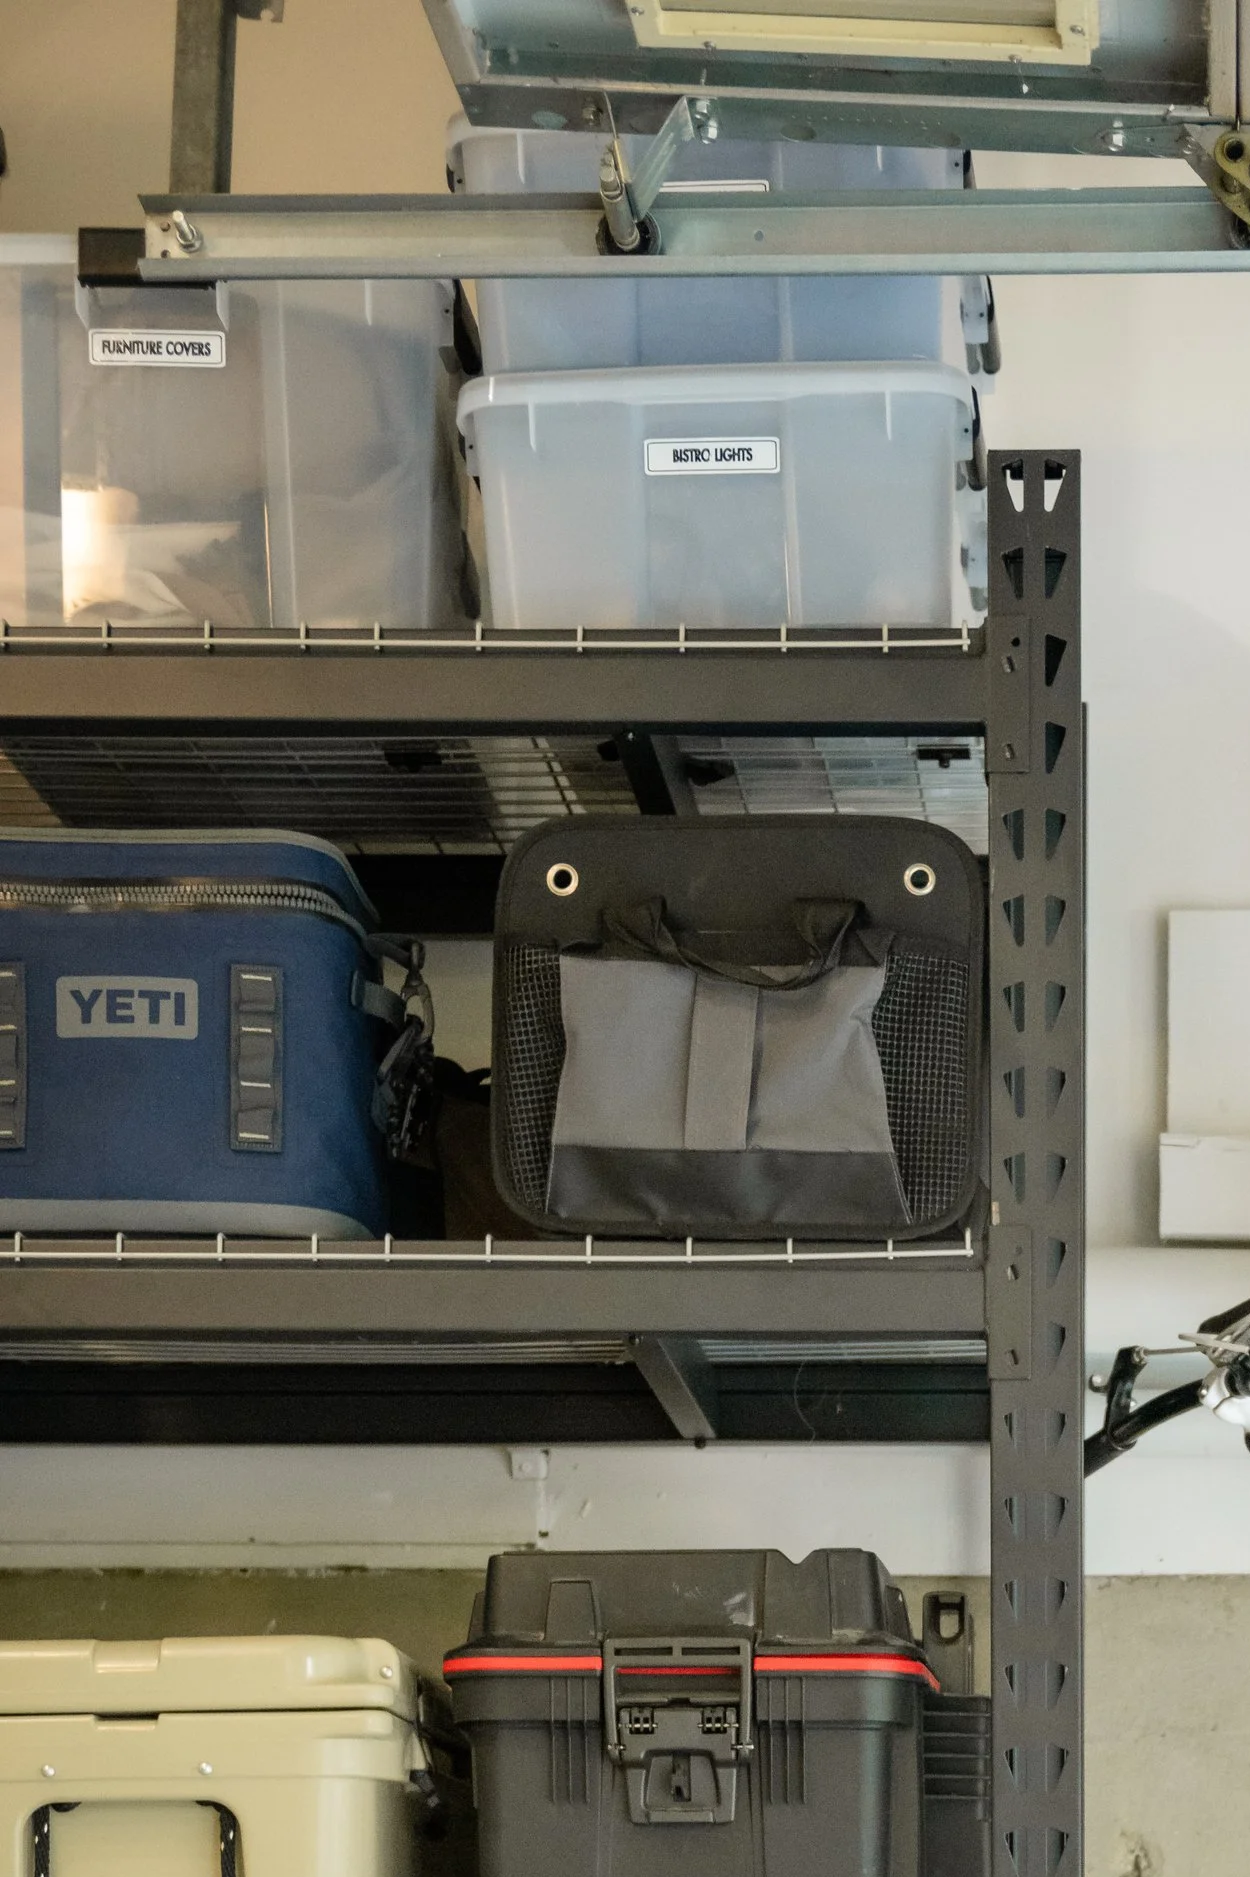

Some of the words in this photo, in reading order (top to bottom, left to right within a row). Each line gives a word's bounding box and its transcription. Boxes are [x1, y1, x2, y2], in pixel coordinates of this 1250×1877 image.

[102, 339, 163, 356] FURNITURE
[165, 341, 212, 357] COVERS
[672, 448, 711, 464] BISTRO
[714, 447, 753, 463] LIGHTS
[69, 988, 186, 1027] YETI
